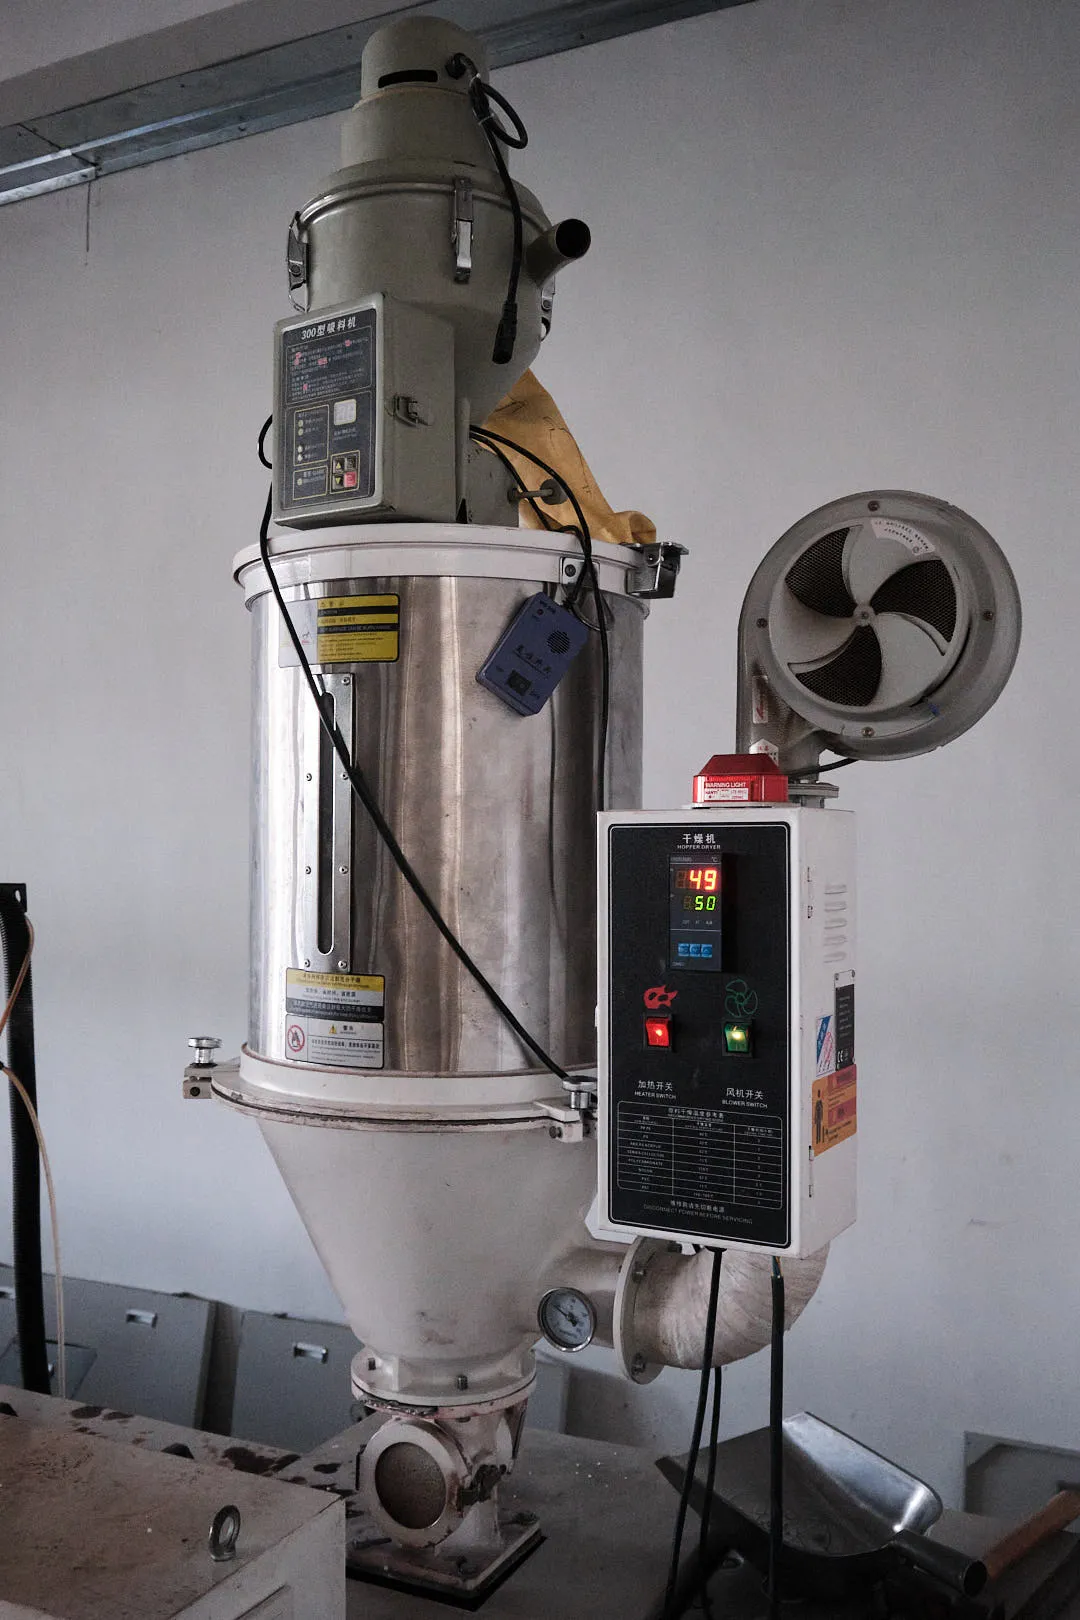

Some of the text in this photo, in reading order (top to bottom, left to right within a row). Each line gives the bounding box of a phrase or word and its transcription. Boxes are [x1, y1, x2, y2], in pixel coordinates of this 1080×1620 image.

[682, 833, 716, 845] 干燥机
[689, 869, 717, 891] 49
[695, 895, 717, 911] 50
[637, 1080, 673, 1092] 加热开关
[634, 1090, 656, 1099] HEATER
[726, 1087, 764, 1101] 风机开关
[721, 1099, 768, 1109] BLOWER SWITCH
